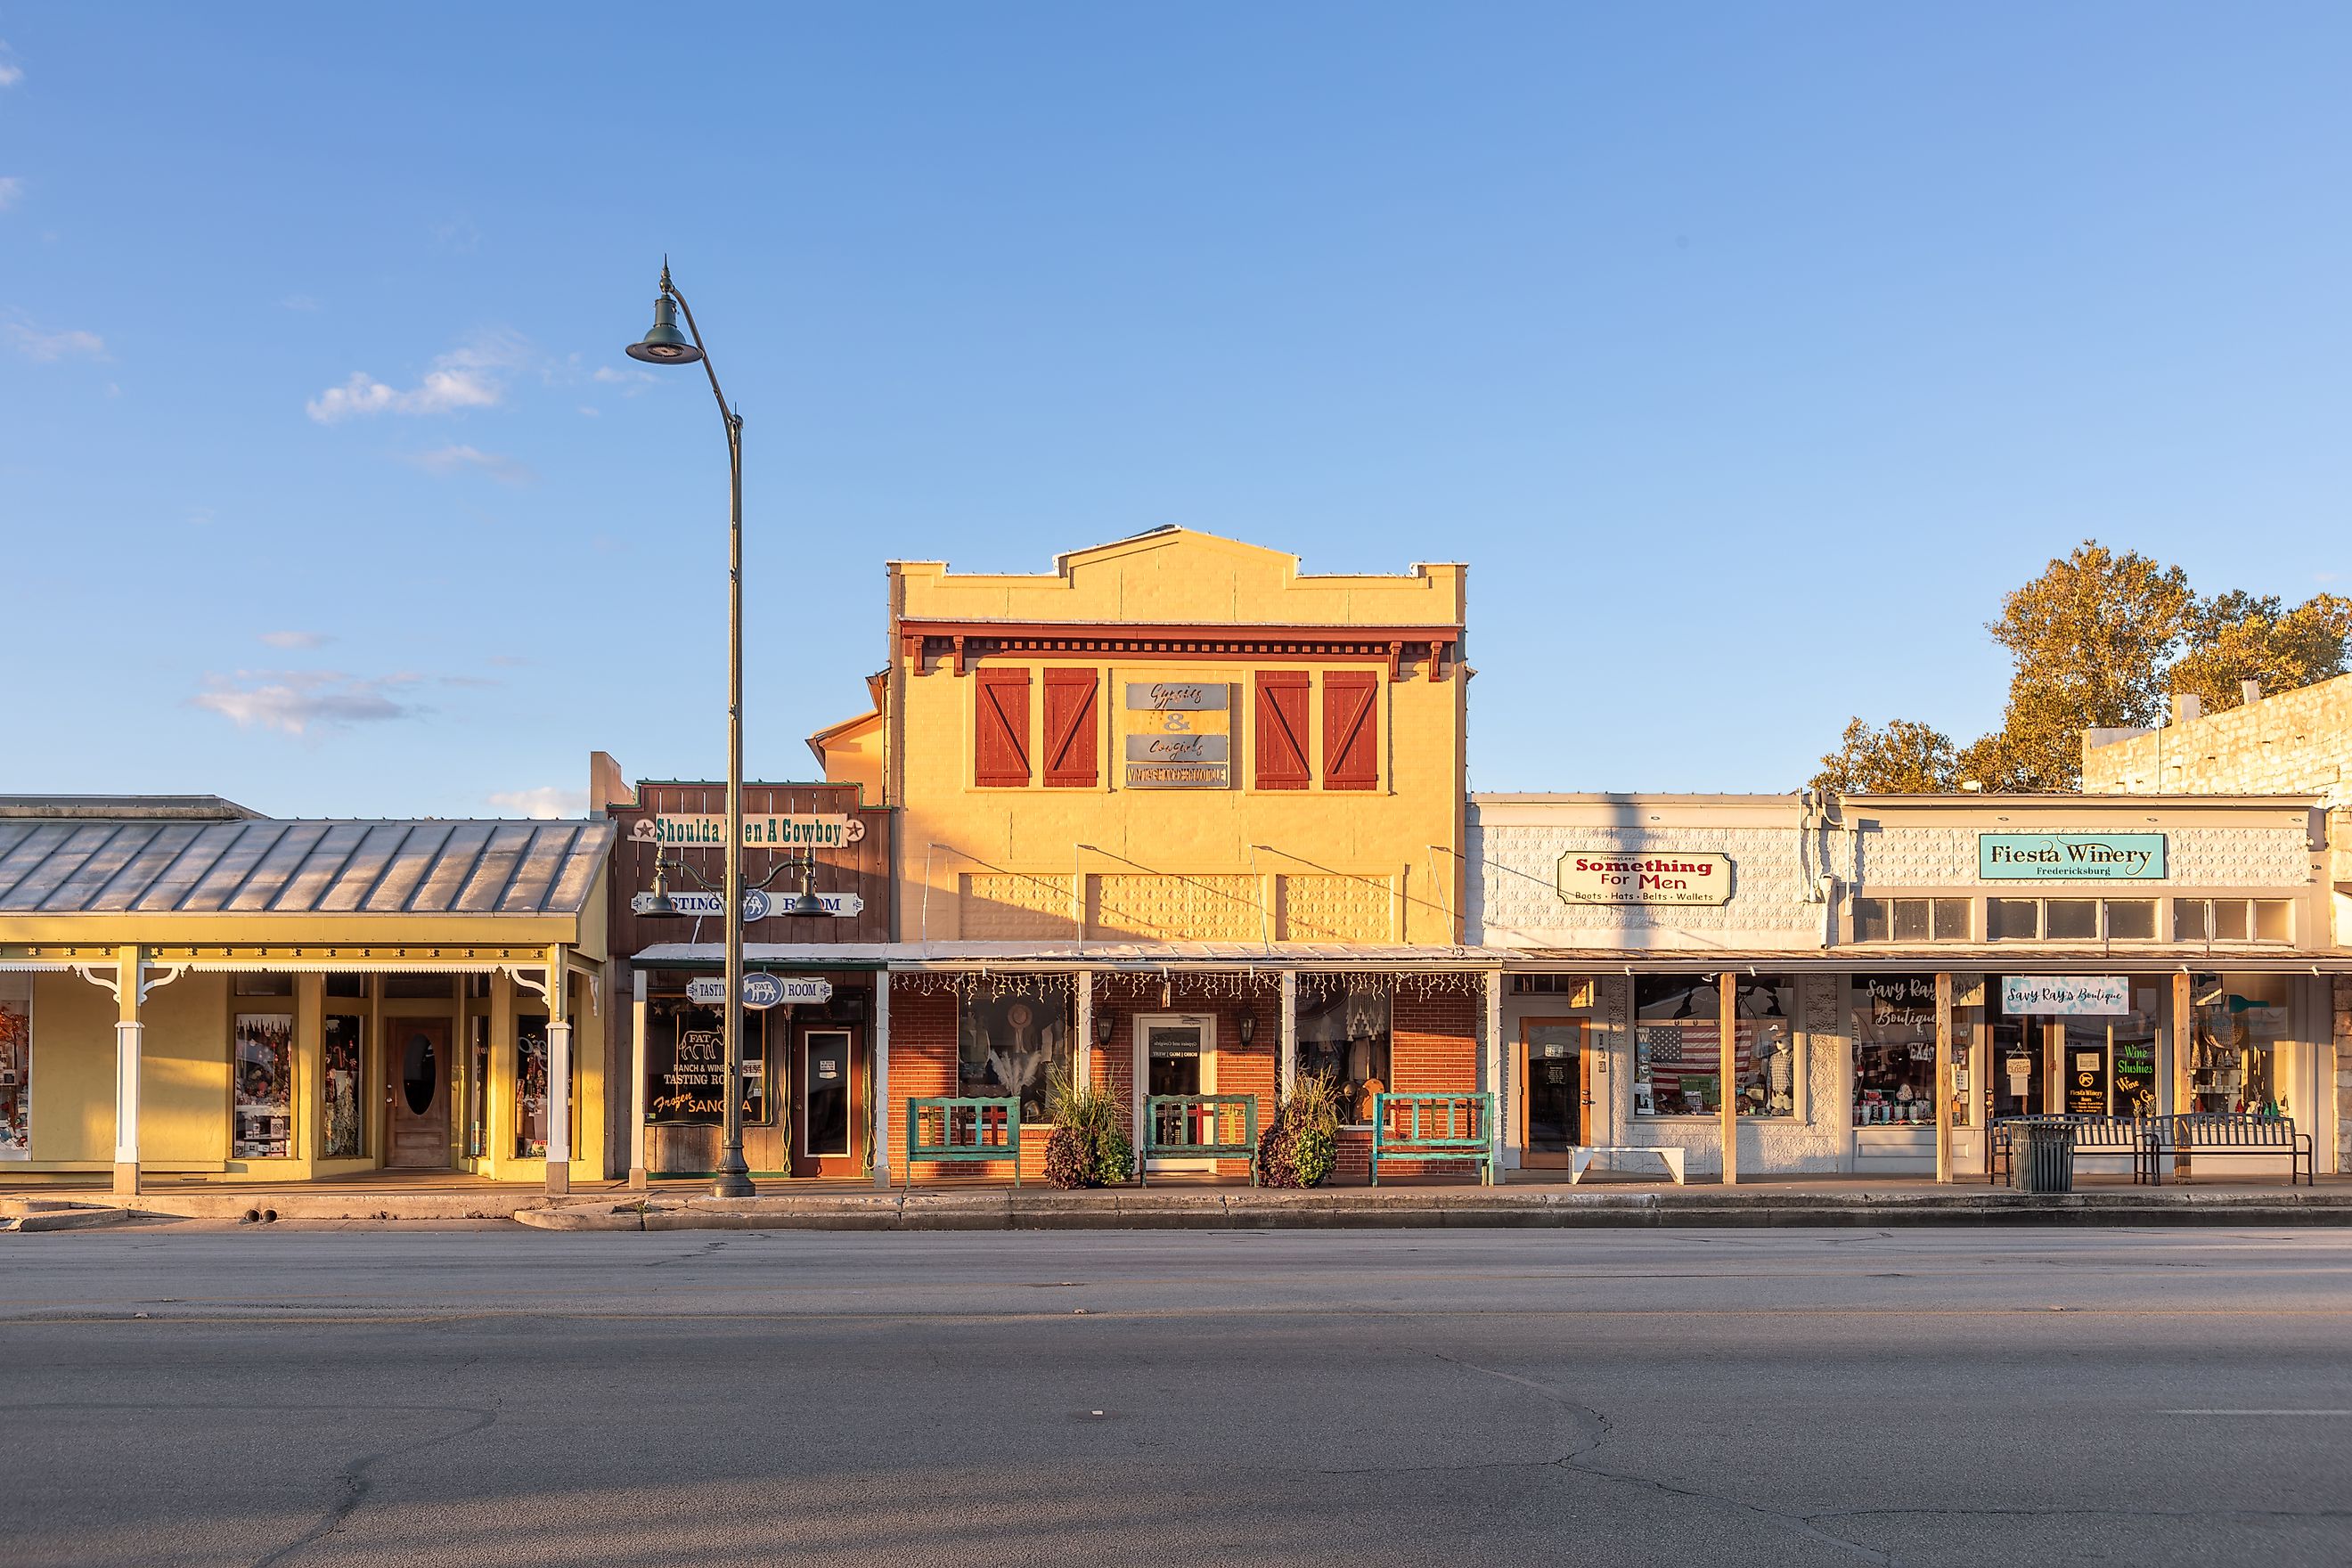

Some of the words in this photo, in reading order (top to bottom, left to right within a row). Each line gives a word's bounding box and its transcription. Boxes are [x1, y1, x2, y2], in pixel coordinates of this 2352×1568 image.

[1150, 684, 1202, 708] Gypsies
[1164, 714, 1190, 731] &
[1149, 735, 1203, 761] Cowgirls
[657, 818, 719, 843] Shoulda
[768, 819, 777, 842] A
[783, 819, 842, 845] Cowboy
[1991, 841, 2062, 862] Fiesta
[2058, 836, 2152, 876] Winery
[1576, 859, 1712, 876] Something
[2037, 867, 2111, 876] Fredericksburg
[1601, 874, 1629, 885] For
[1638, 874, 1686, 889] Men
[646, 897, 720, 910] STING
[783, 898, 842, 911] RM
[1575, 892, 1602, 900] Boots
[1611, 892, 1634, 900] Hats
[1677, 893, 1713, 901] Wallets
[699, 984, 726, 996] TASTIN
[788, 984, 816, 996] ROOM
[1866, 979, 1907, 1000] Savy
[2008, 988, 2039, 1003] Savy
[2042, 988, 2075, 1003] Ray's
[2078, 988, 2122, 1004] Boutique
[1875, 1007, 1936, 1032] Boutique
[690, 1034, 711, 1042] FAT
[2124, 1044, 2148, 1058] Wine
[2118, 1060, 2153, 1074] Slushies
[664, 1074, 708, 1085] TASTING
[711, 1074, 725, 1085] RO
[2115, 1076, 2139, 1092] Wine
[653, 1092, 692, 1113] Frozen
[689, 1100, 752, 1113] SANGA
